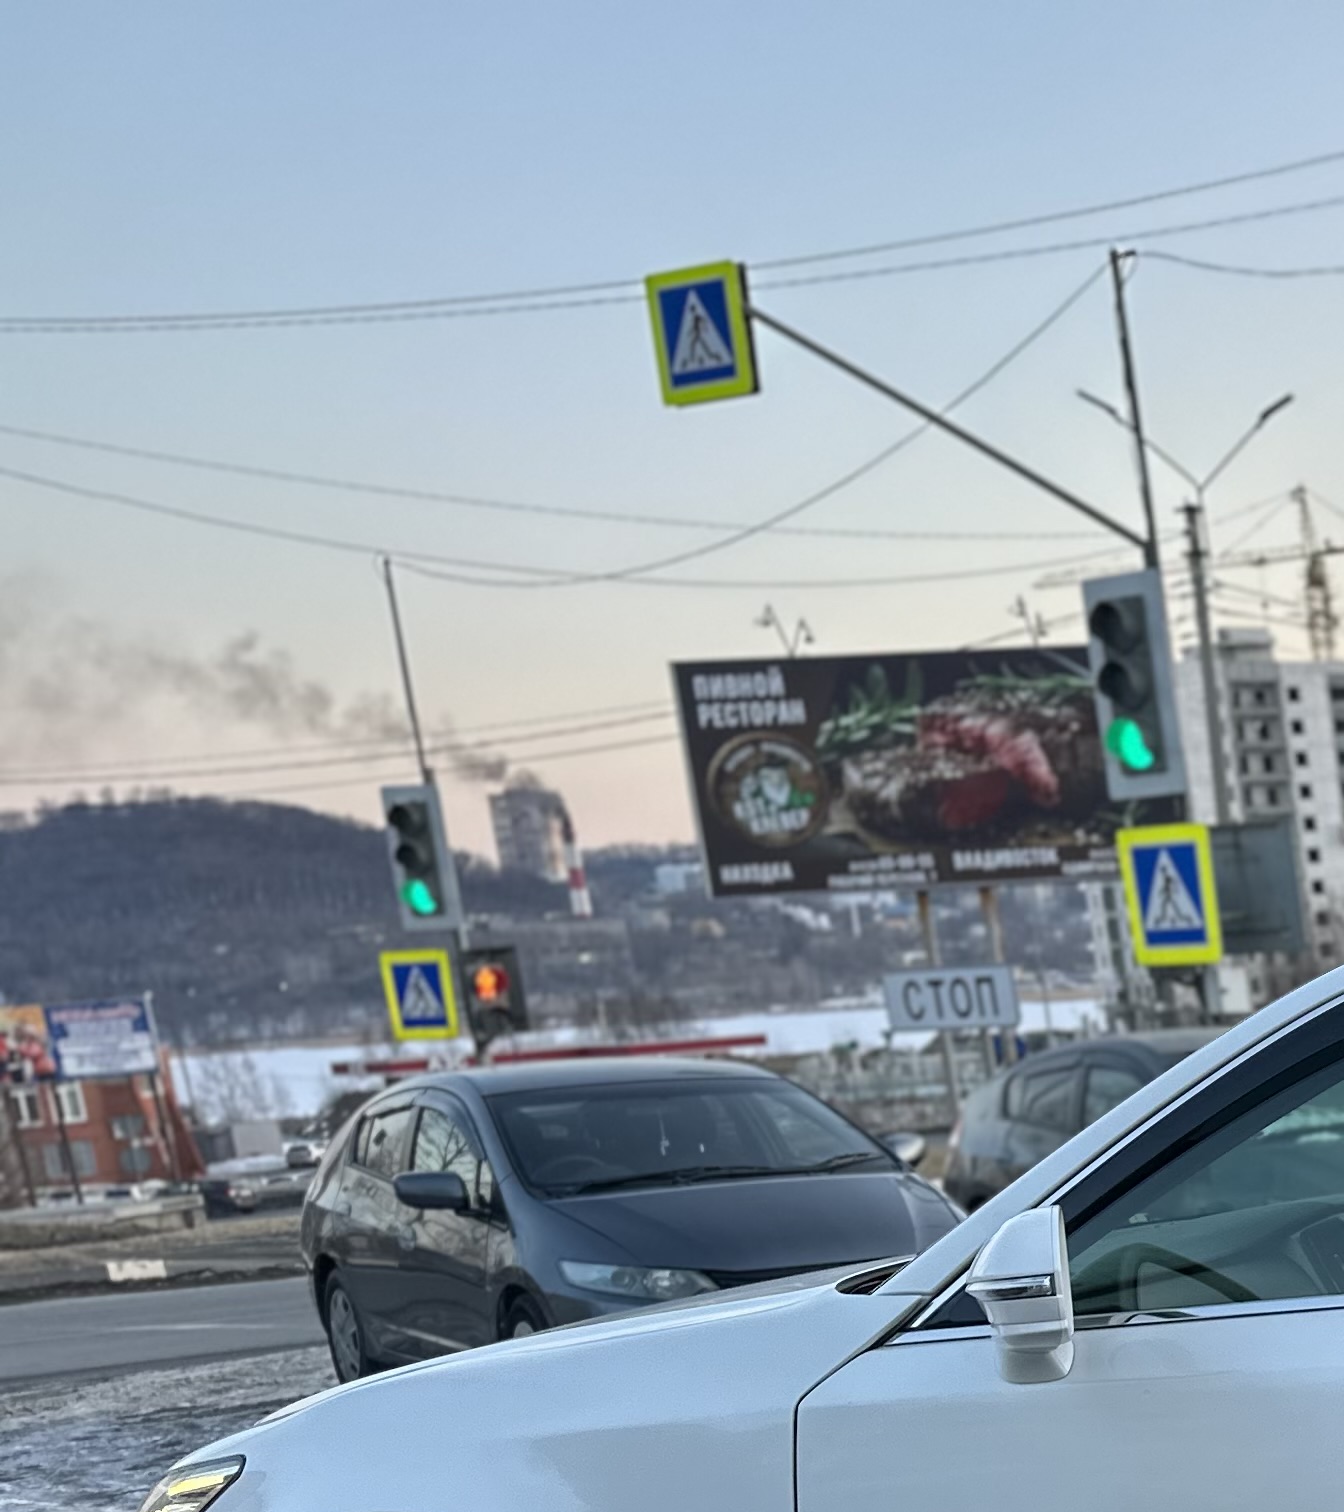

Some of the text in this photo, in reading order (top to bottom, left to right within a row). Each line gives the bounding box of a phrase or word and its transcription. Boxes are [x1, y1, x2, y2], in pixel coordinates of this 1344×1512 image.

[693, 666, 785, 700] ПИВНОЙ
[698, 699, 806, 728] РЕСТОРАН
[902, 976, 999, 1021] СТОП
